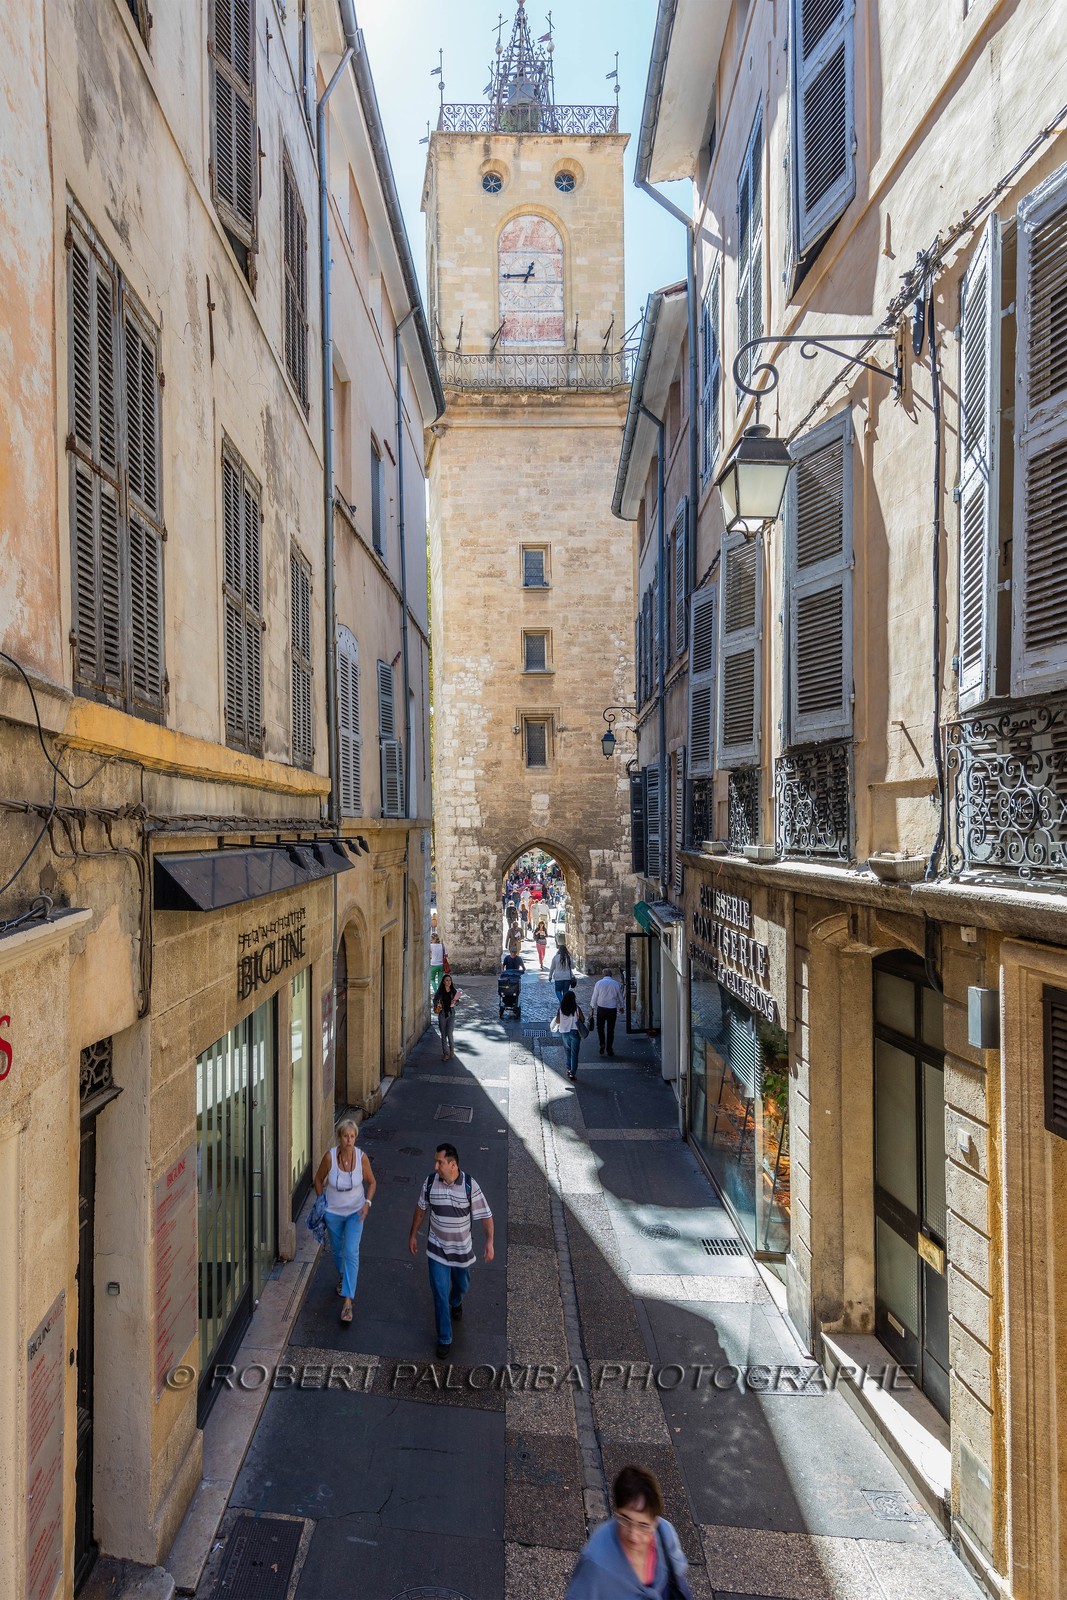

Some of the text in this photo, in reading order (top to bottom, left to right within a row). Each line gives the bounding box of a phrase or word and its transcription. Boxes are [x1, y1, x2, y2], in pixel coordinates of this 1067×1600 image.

[701, 884, 750, 930] PATISSERIE
[238, 925, 306, 1000] BIGUINE
[693, 912, 767, 977] CONFISERIE
[726, 968, 775, 1023] CALISSONS
